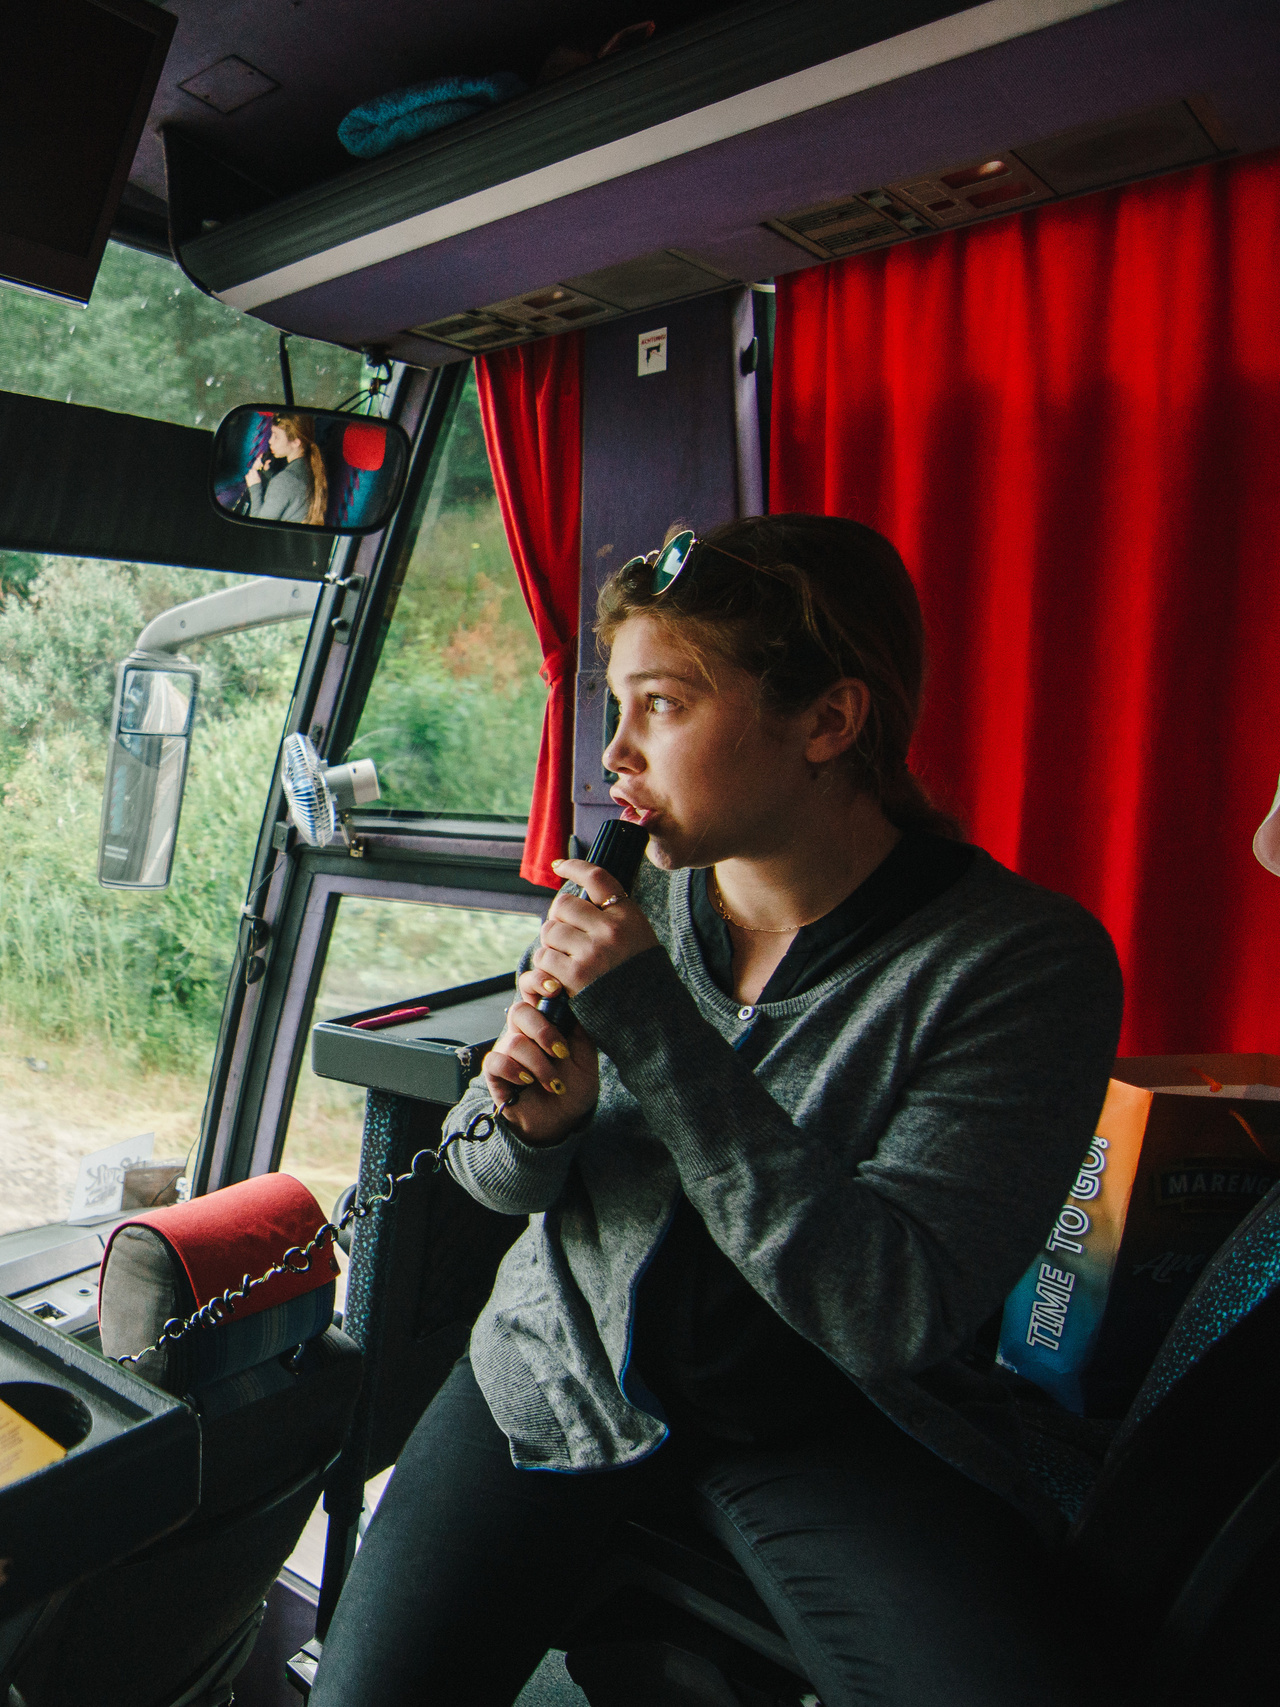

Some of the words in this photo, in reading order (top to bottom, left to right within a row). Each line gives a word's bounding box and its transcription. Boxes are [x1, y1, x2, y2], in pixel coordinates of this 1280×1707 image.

[1167, 1172, 1272, 1195] MARENG
[1045, 1204, 1090, 1254] TO
[1026, 1262, 1076, 1351] TIME
